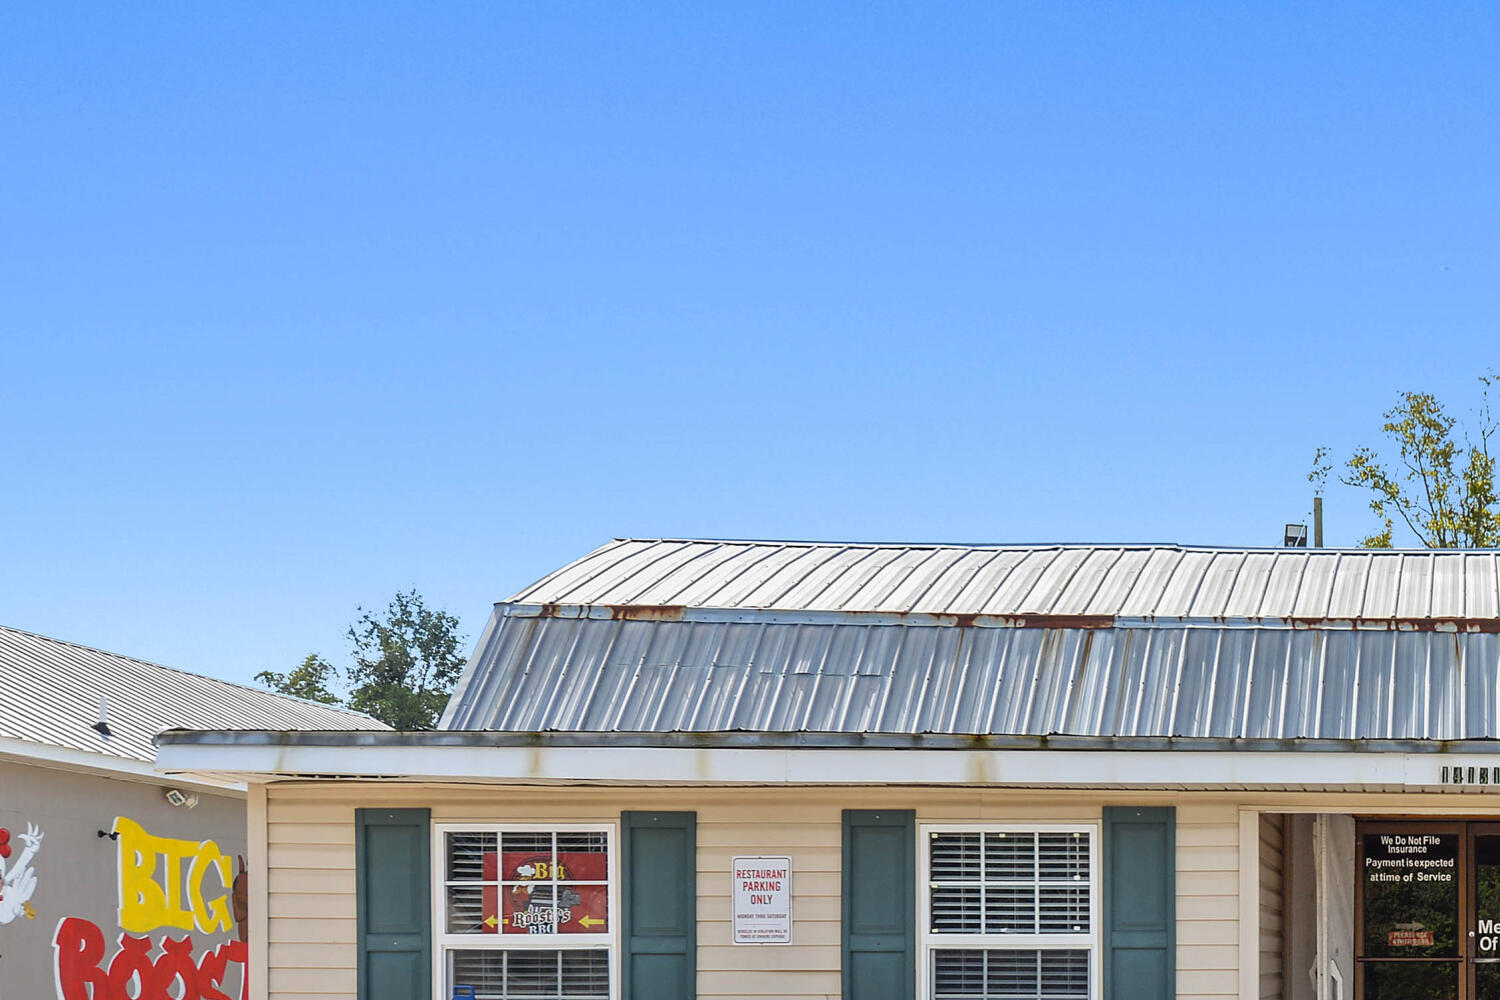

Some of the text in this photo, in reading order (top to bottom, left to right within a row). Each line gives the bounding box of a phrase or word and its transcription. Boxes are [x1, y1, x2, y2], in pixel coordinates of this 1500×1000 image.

[1441, 766, 1500, 784] 14131
[1381, 836, 1441, 845] We Do Not File
[1388, 845, 1427, 853] Insurance
[1366, 858, 1454, 869] Payment is expected
[111, 816, 233, 934] BIG
[736, 869, 787, 879] RESTAURANT
[1370, 872, 1452, 882] at time of Service
[743, 881, 781, 892] PARKING
[750, 894, 773, 905] ONLY
[1479, 936, 1499, 951] Of
